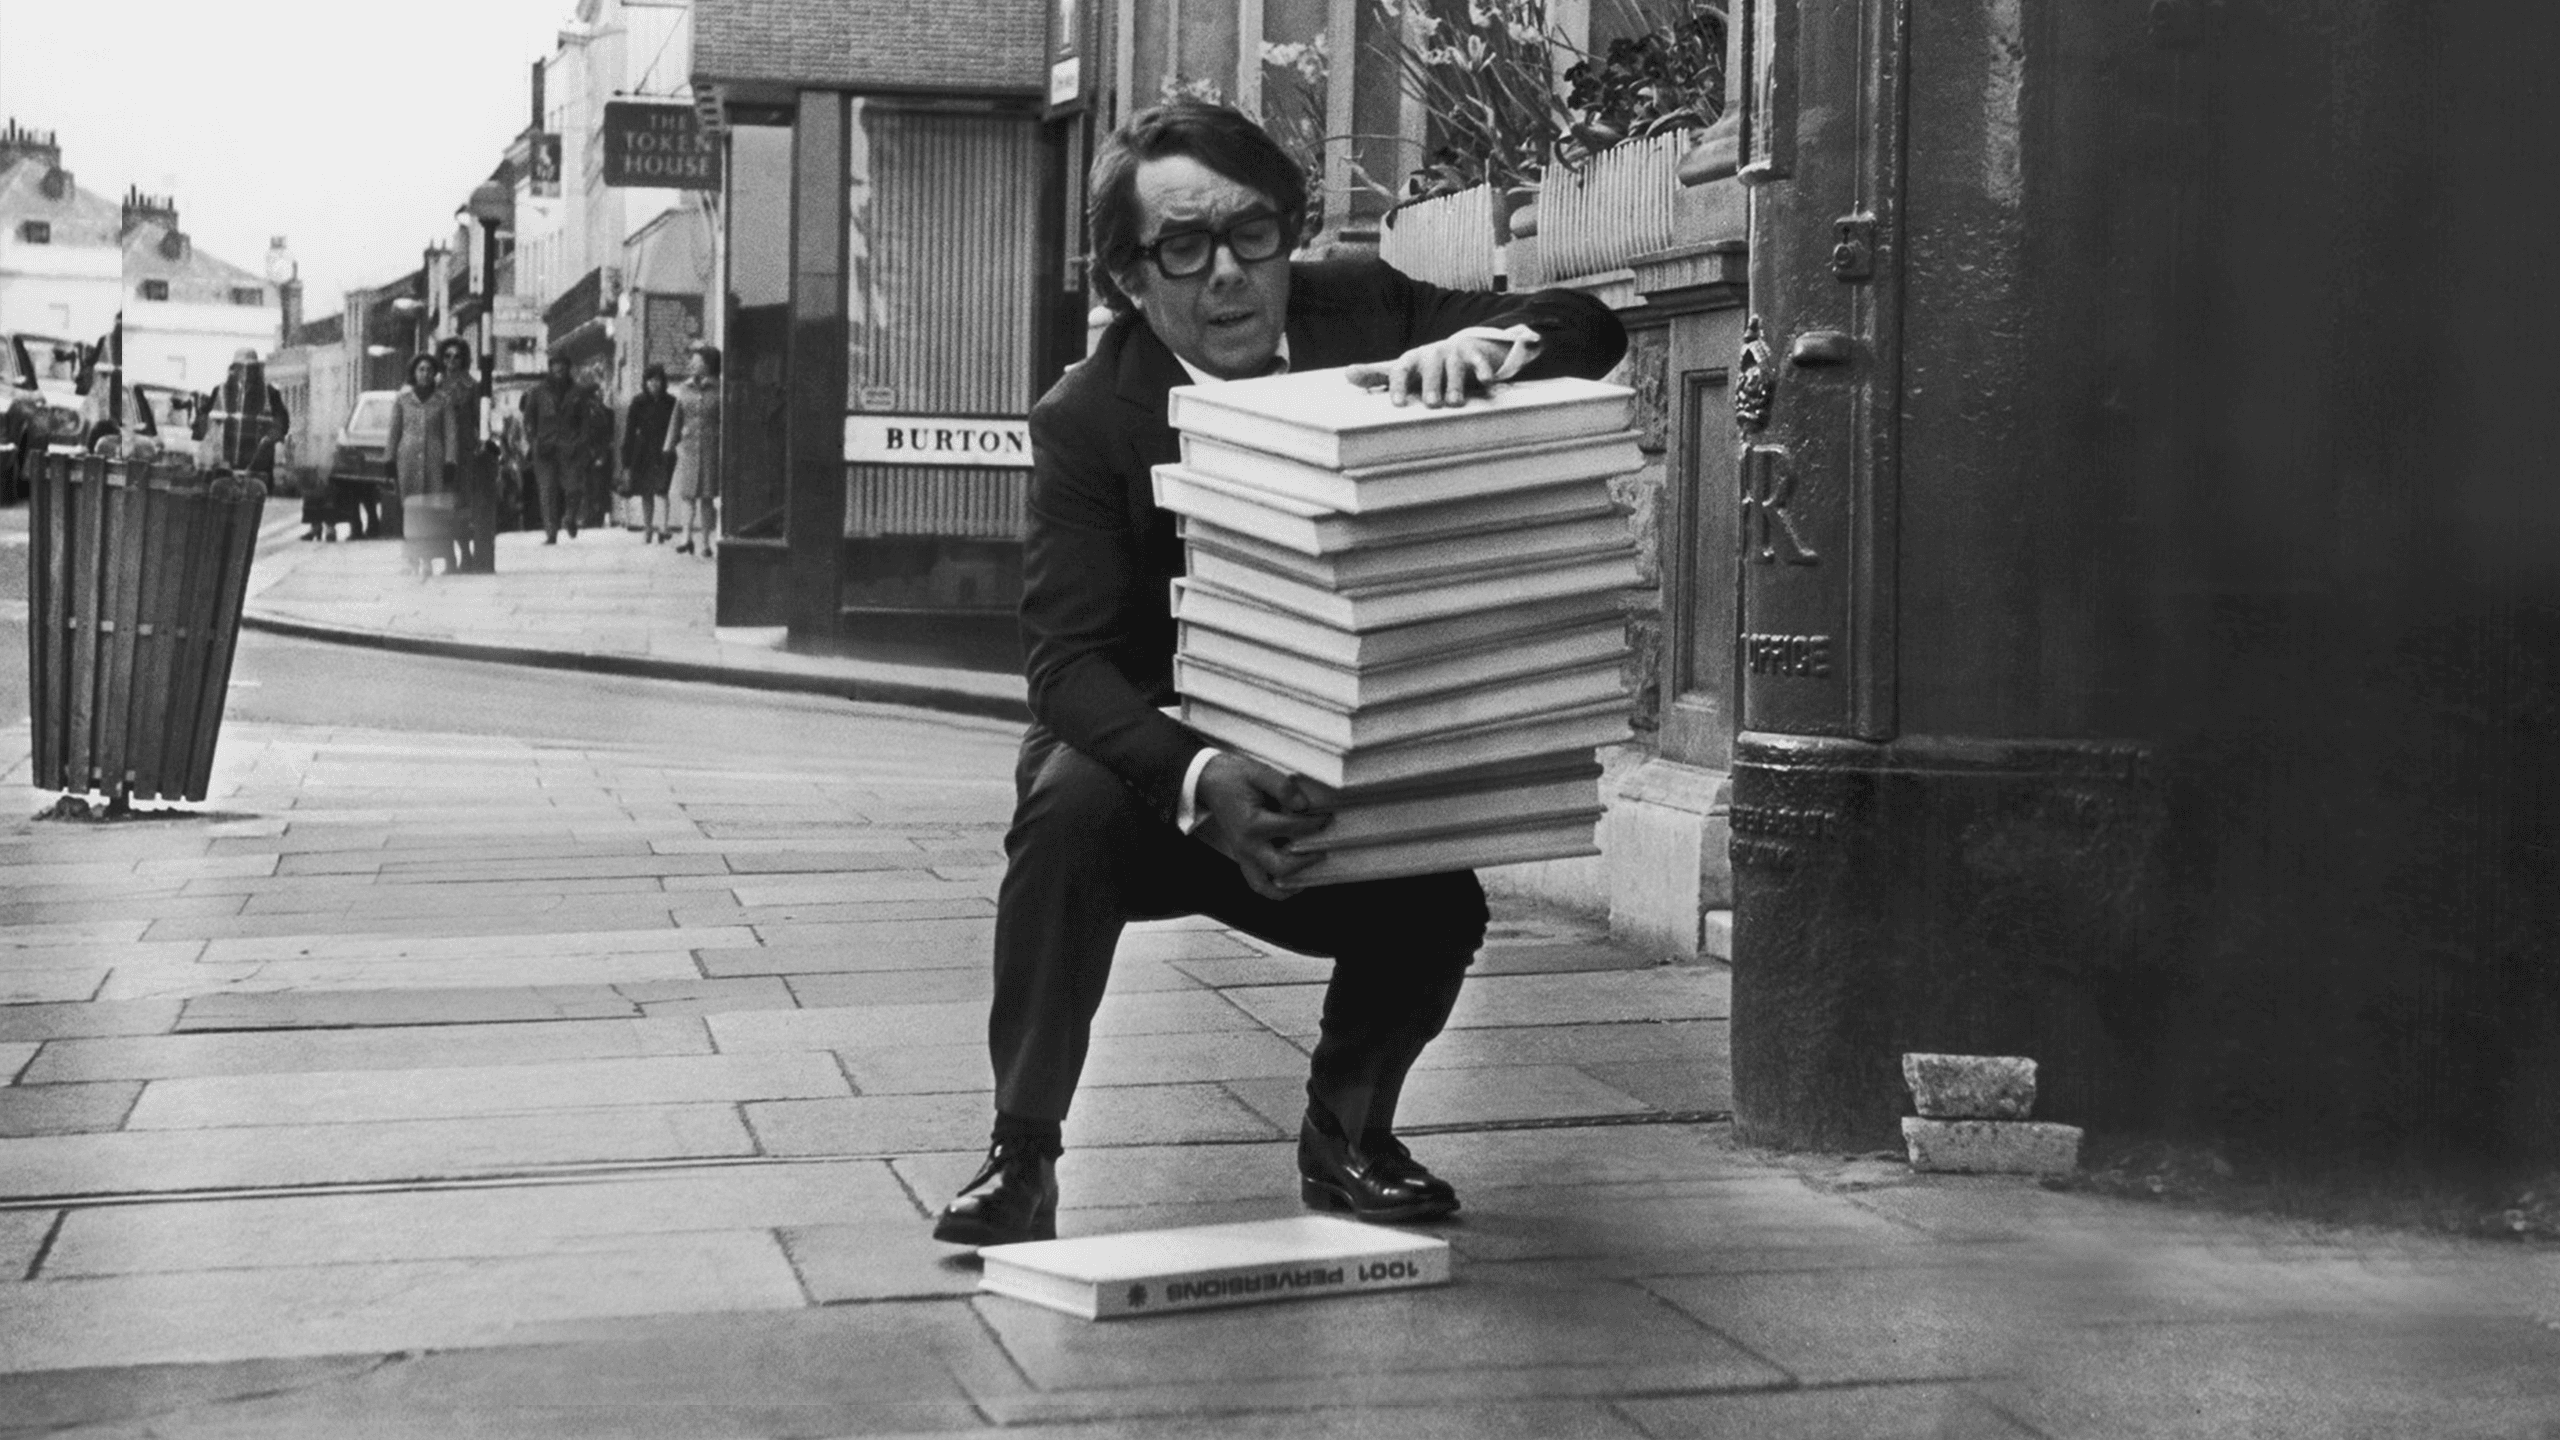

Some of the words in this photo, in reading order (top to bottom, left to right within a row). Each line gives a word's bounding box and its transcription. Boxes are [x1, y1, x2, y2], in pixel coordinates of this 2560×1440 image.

[651, 114, 686, 131] THE
[626, 131, 711, 153] TOKEN
[625, 153, 710, 177] HOUSE
[887, 427, 1024, 453] BURTON
[1358, 1261, 1419, 1281] 1001
[1166, 1266, 1344, 1302] PERVERSIONS
